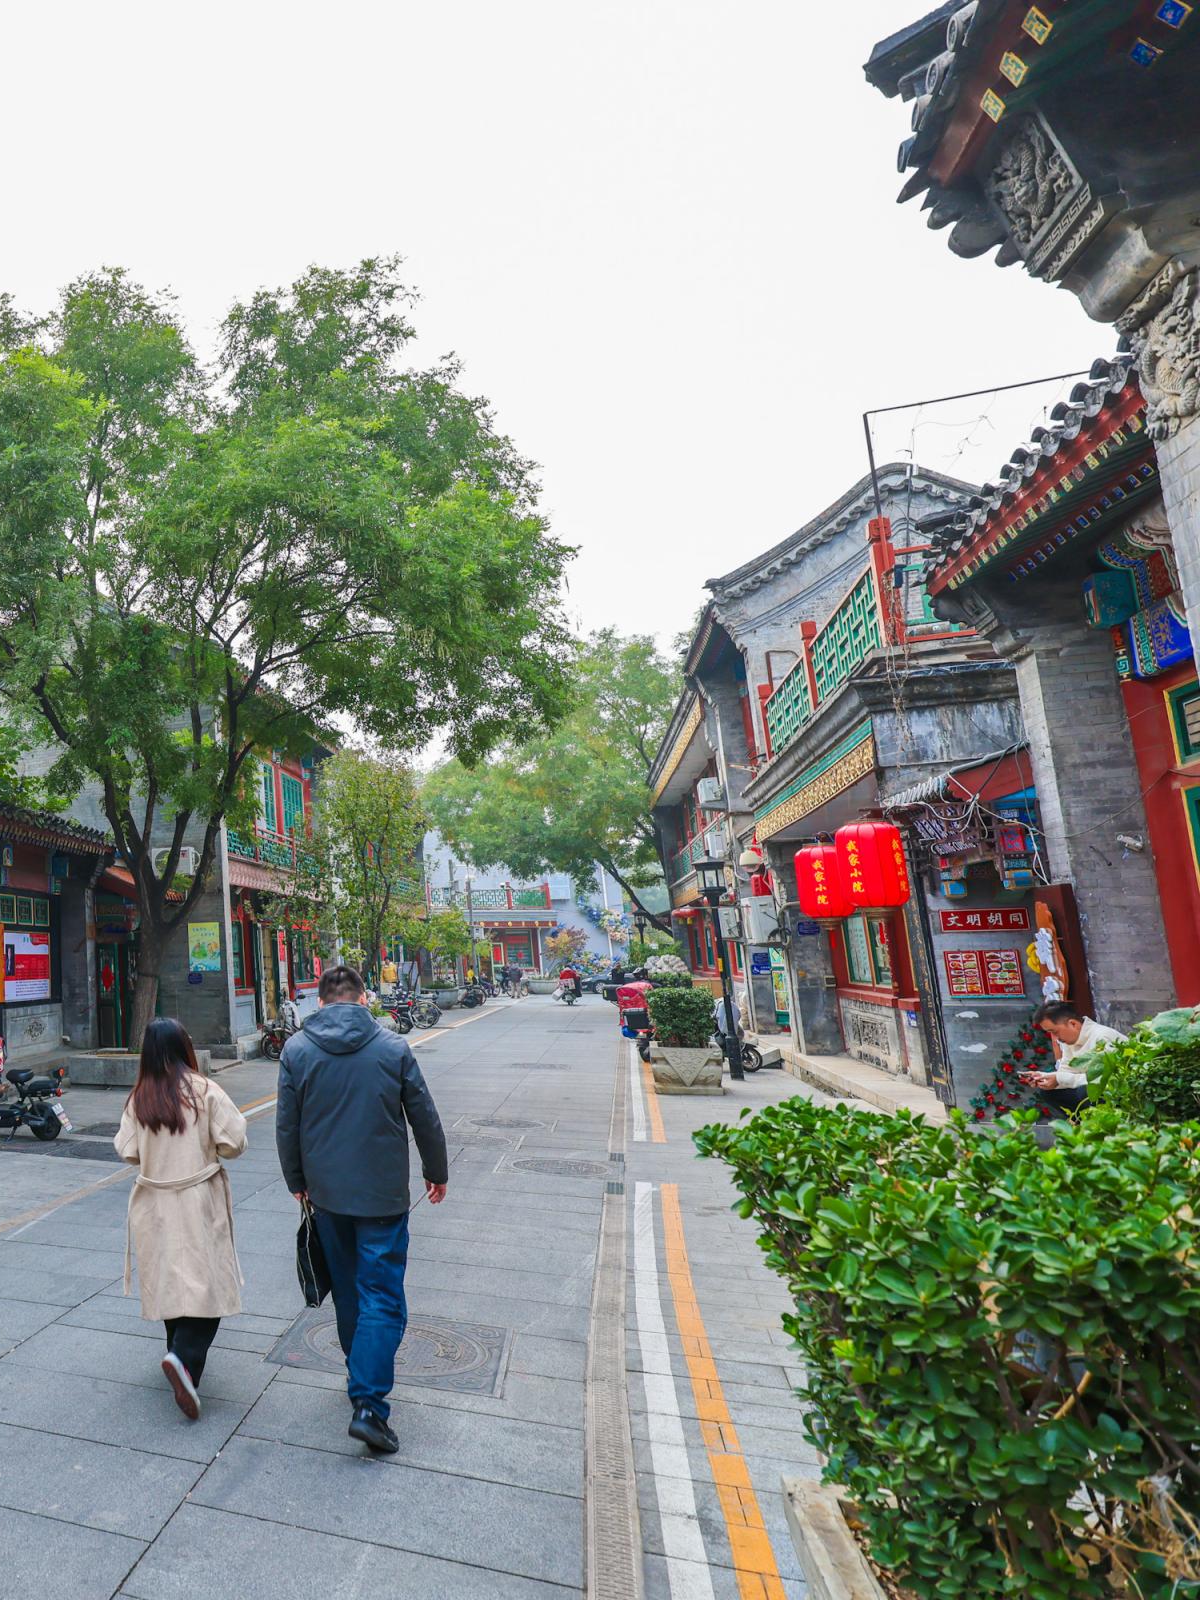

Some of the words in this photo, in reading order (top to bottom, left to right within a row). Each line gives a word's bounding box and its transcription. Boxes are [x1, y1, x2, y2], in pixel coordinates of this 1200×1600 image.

[812, 859, 829, 905] 我家小院
[846, 840, 864, 893] 我家小院
[946, 912, 1024, 927] 文明胡同
